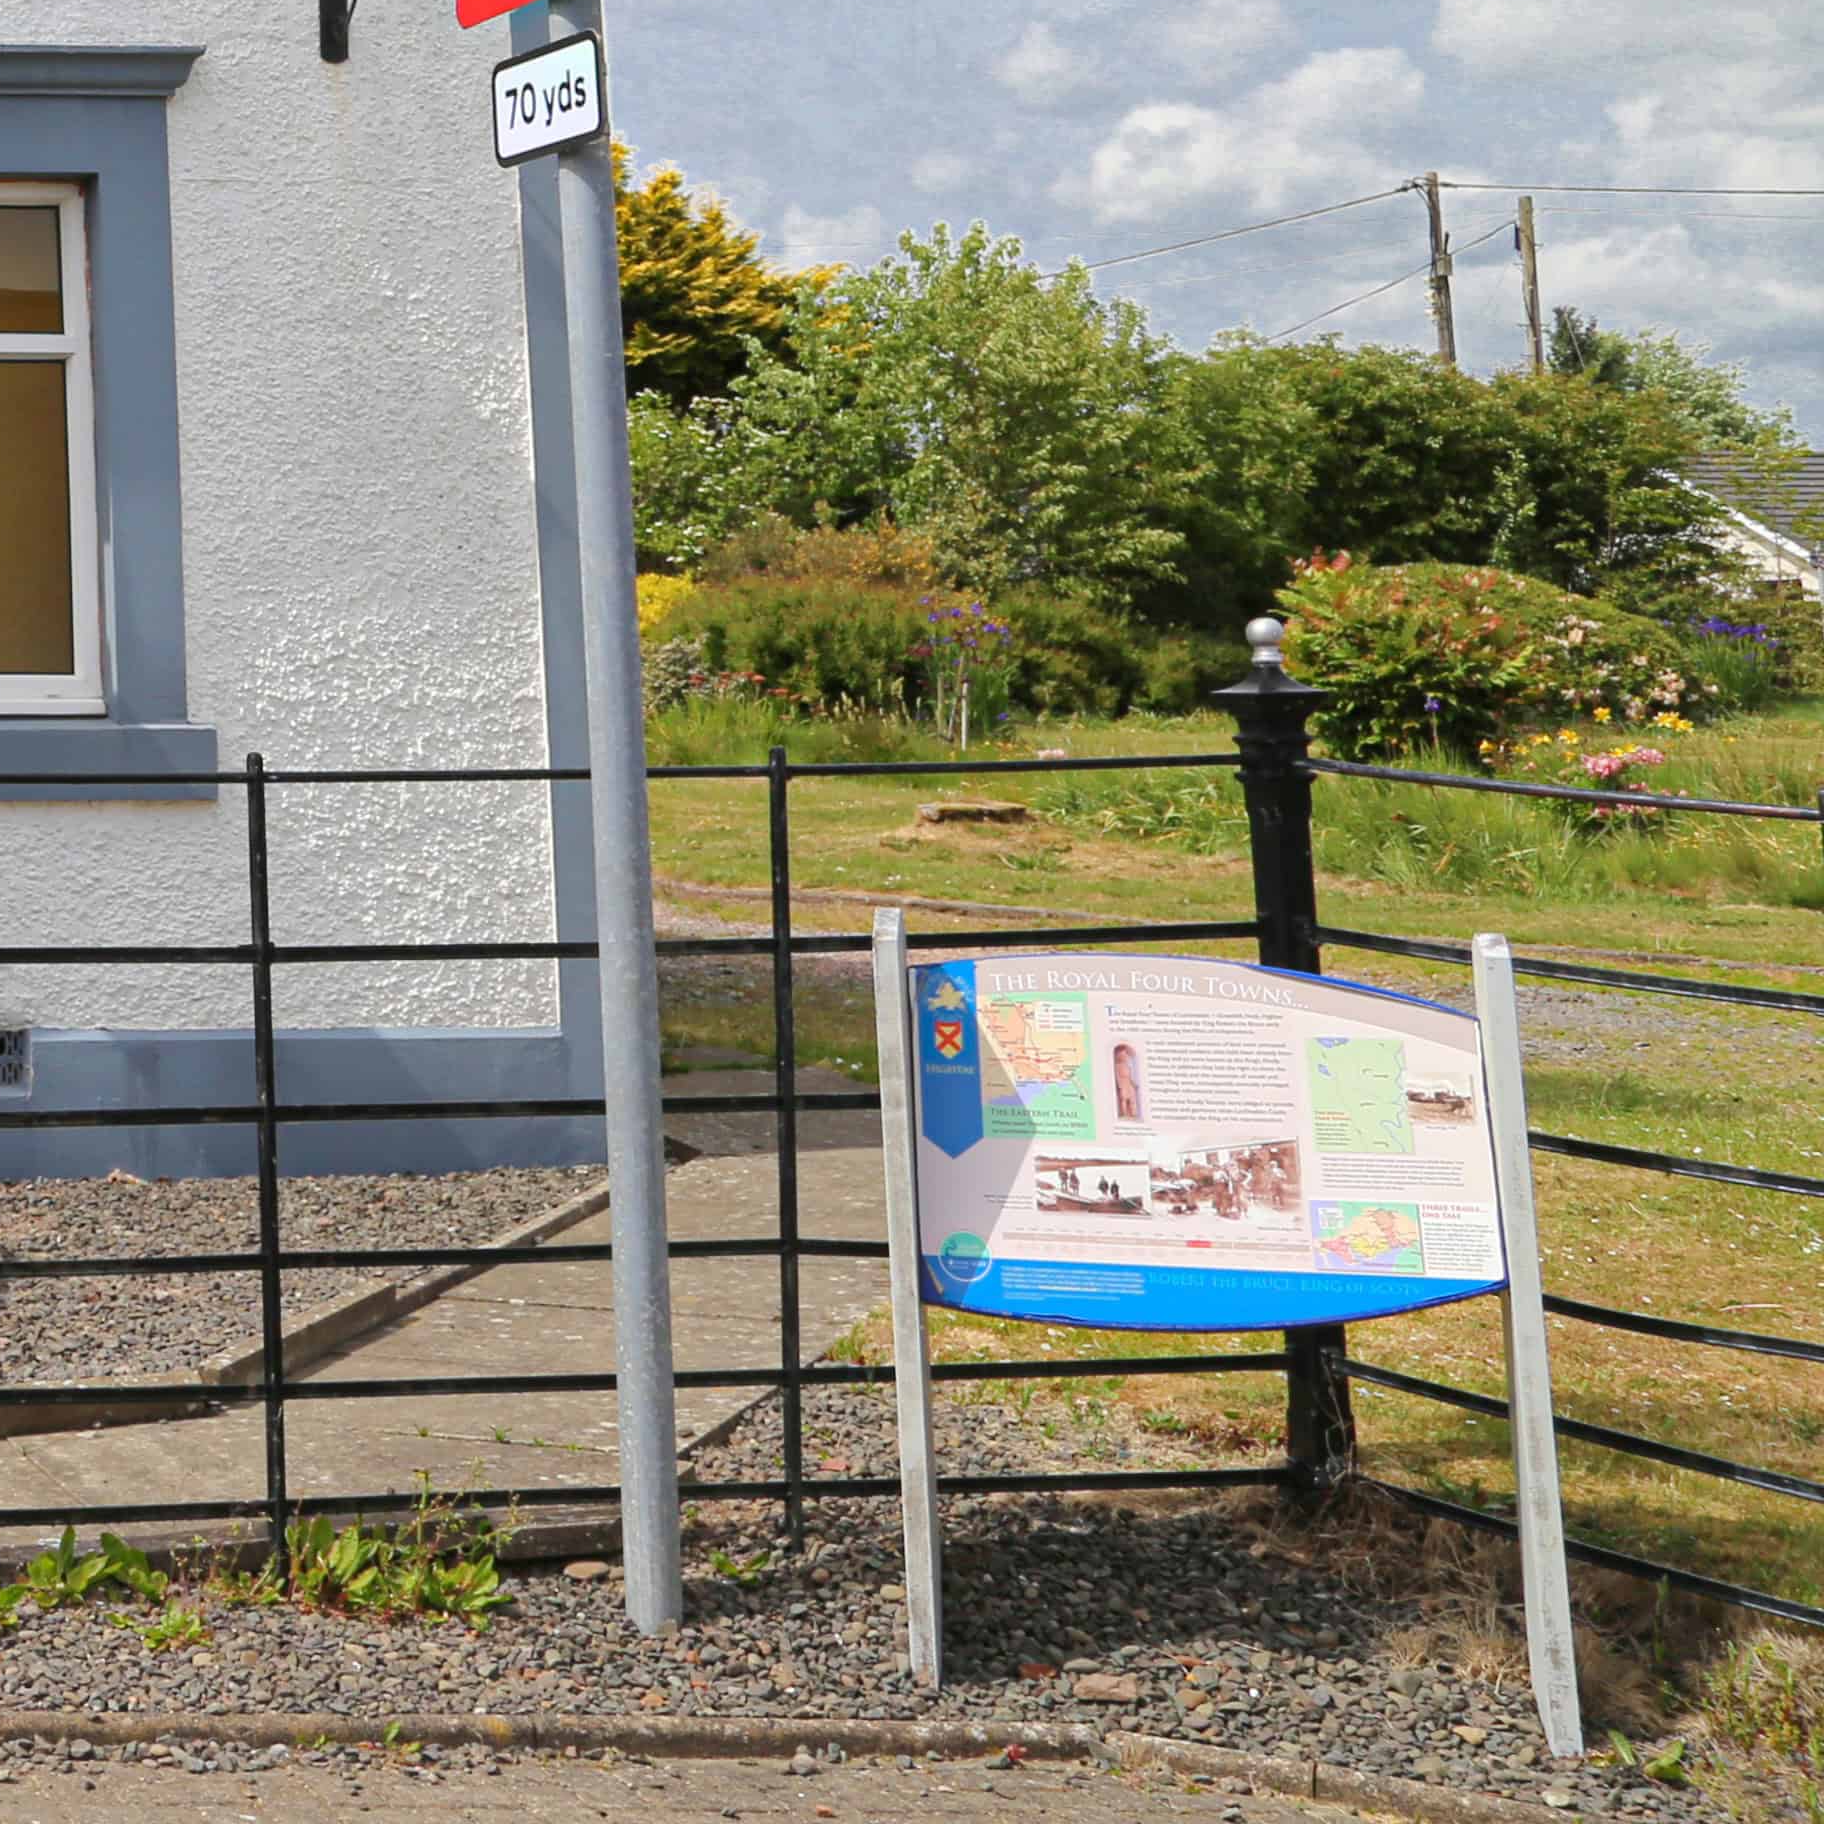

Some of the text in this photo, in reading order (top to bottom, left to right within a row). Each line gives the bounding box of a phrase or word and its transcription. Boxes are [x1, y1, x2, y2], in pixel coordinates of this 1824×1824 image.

[505, 69, 587, 129] 70 yds
[990, 973, 1040, 992] THE
[1047, 970, 1121, 990] ROYAL
[1129, 971, 1196, 994] FOUR
